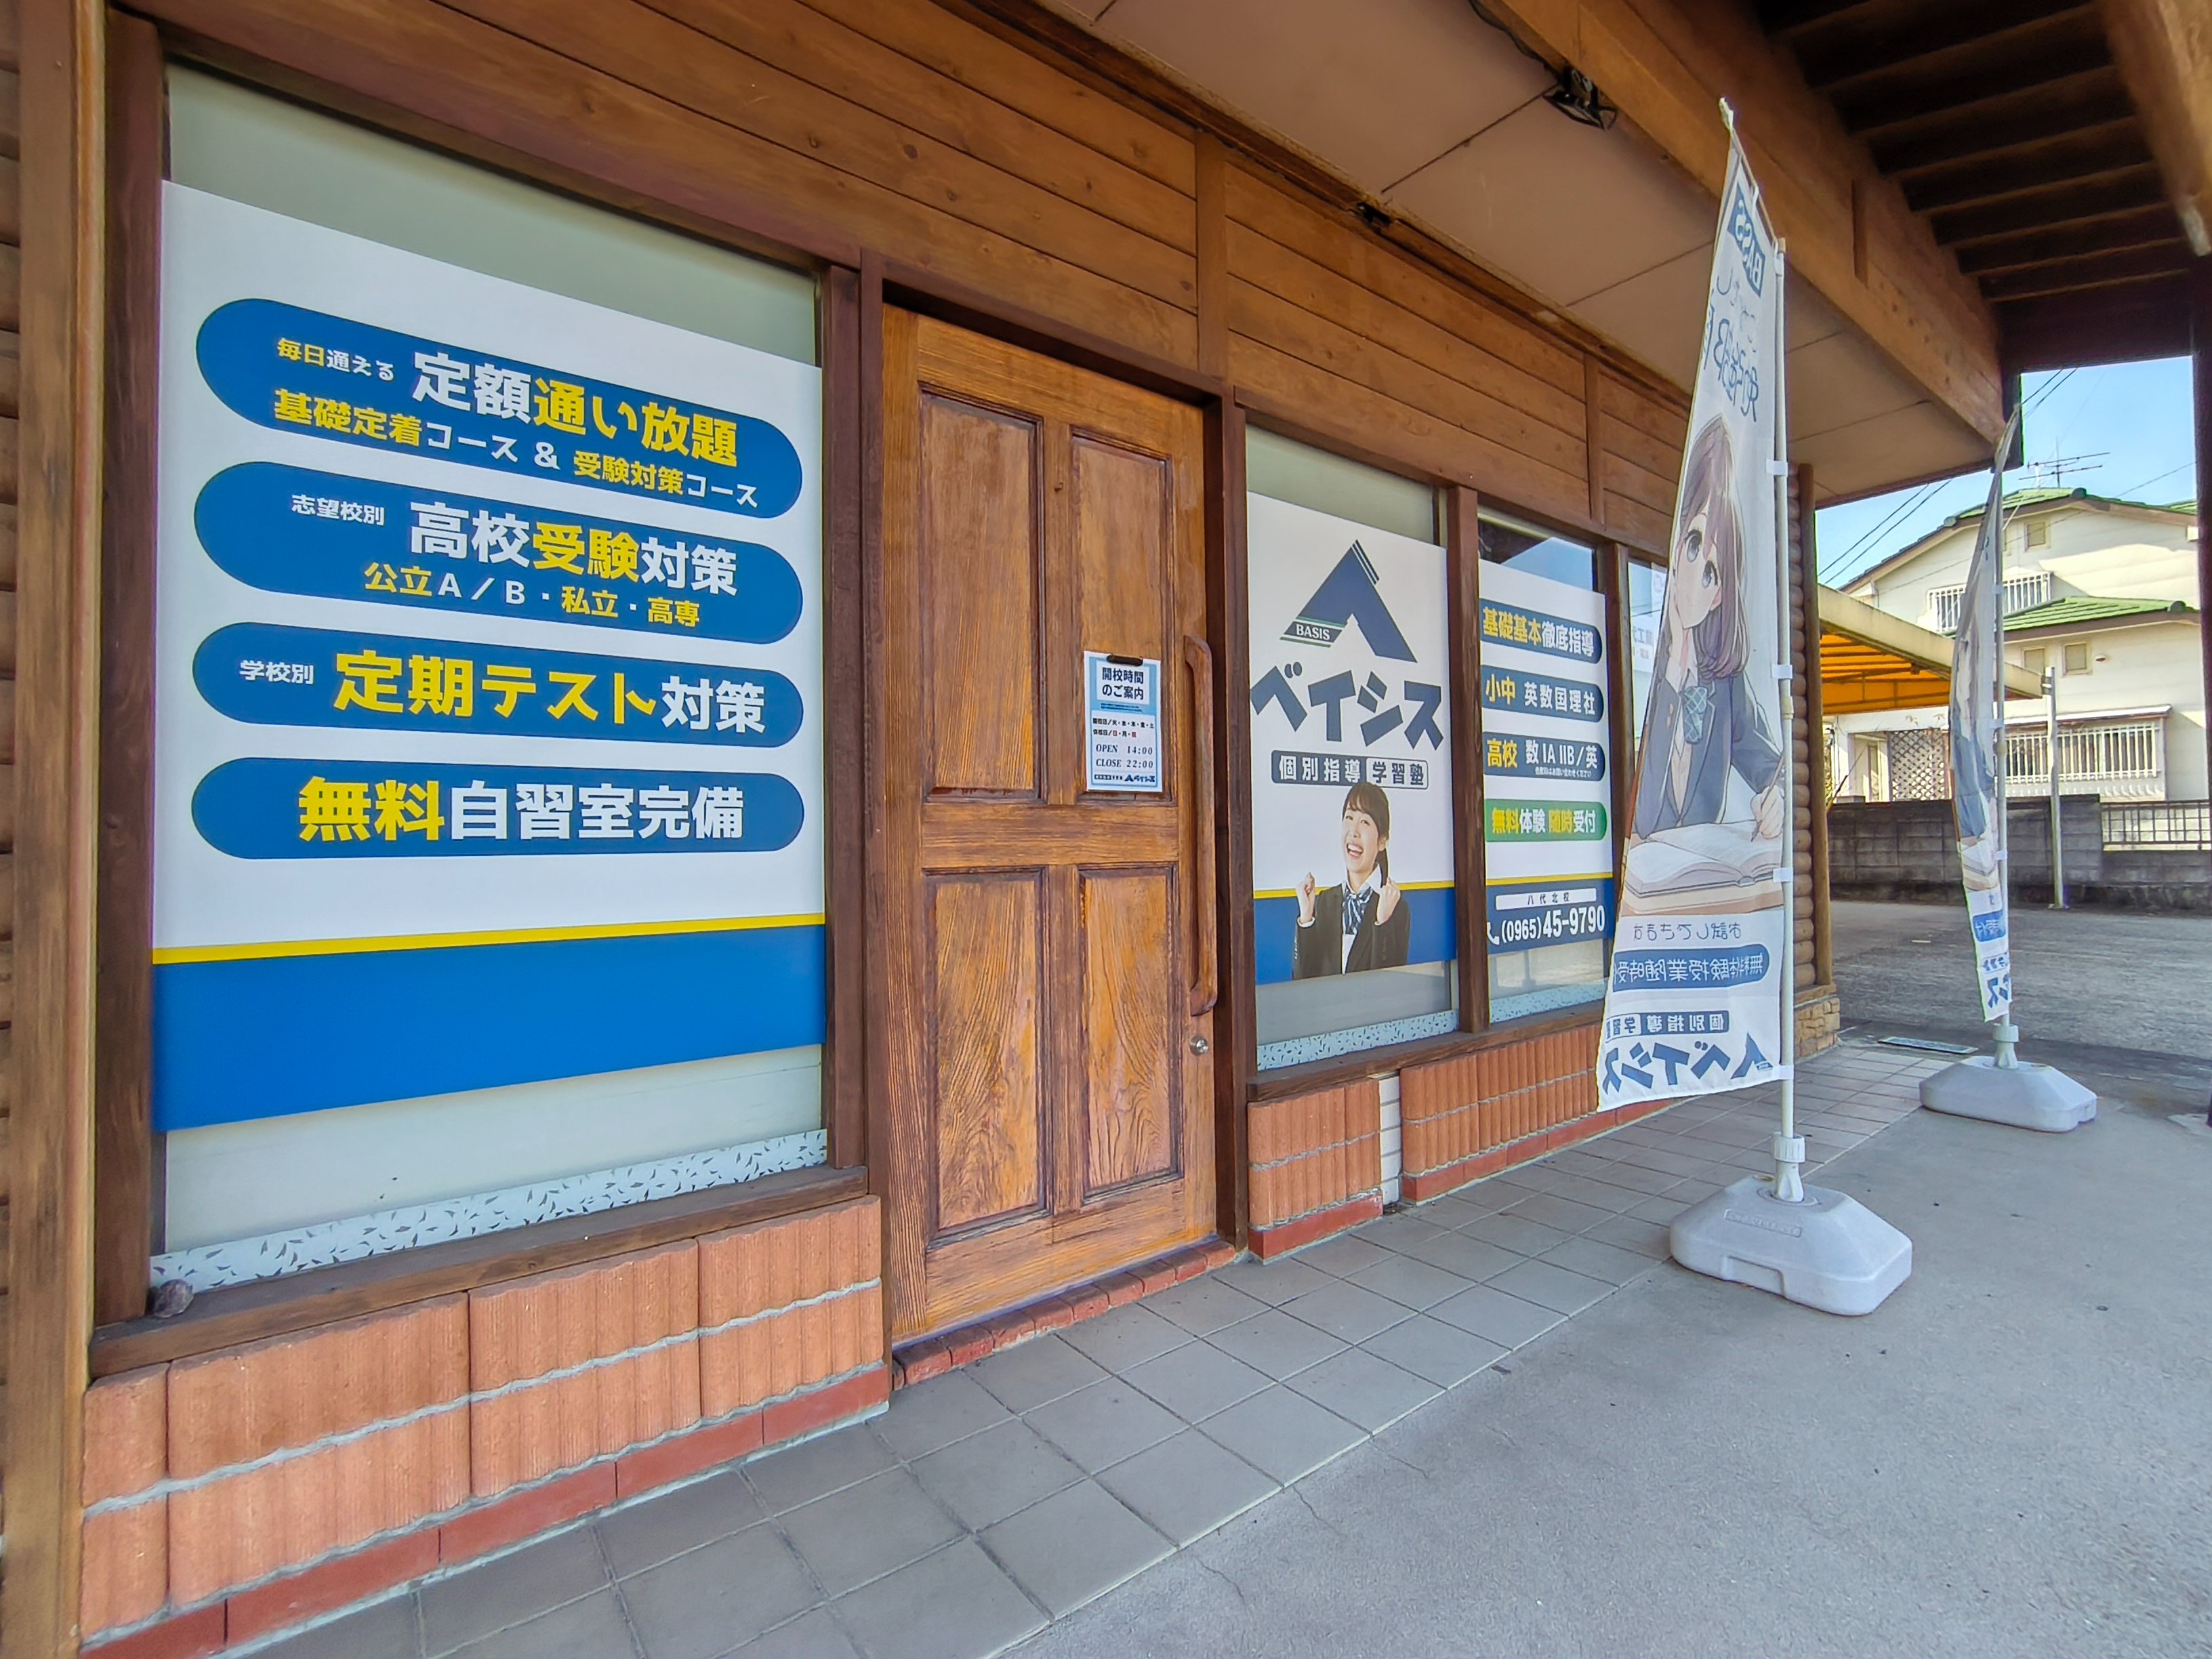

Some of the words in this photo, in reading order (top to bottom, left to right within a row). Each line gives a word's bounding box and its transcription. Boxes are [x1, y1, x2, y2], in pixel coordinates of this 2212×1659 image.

[276, 337, 395, 382] 毎日通える
[411, 351, 738, 468] 定額通い放題
[273, 388, 519, 464] 基礎定着コース
[533, 442, 560, 468] &
[573, 450, 759, 508] 受験対策コース
[291, 493, 385, 527] 志望校別
[409, 500, 738, 596] 高校受験対策
[1296, 623, 1330, 640] BASIS
[1483, 607, 1594, 657] 基礎基本徹底指導
[239, 659, 314, 685] 学校別
[333, 650, 766, 735] 定期テスト対策
[1102, 667, 1144, 684] 開校時間
[1102, 684, 1144, 700] のご案内
[1485, 674, 1516, 705] 小中
[1524, 681, 1595, 715] 英数国理社
[1250, 661, 1444, 751] ベイシス
[1096, 744, 1118, 753] OPEN
[1127, 745, 1153, 755] 14:00
[1096, 758, 1122, 768] CLOSE
[1126, 760, 1153, 769] 22:00
[1487, 738, 1518, 769] 高校
[298, 776, 745, 842] 無料自習室完備
[1492, 808, 1546, 834] 無料体験
[1501, 905, 1605, 943] (0965)45-9790
